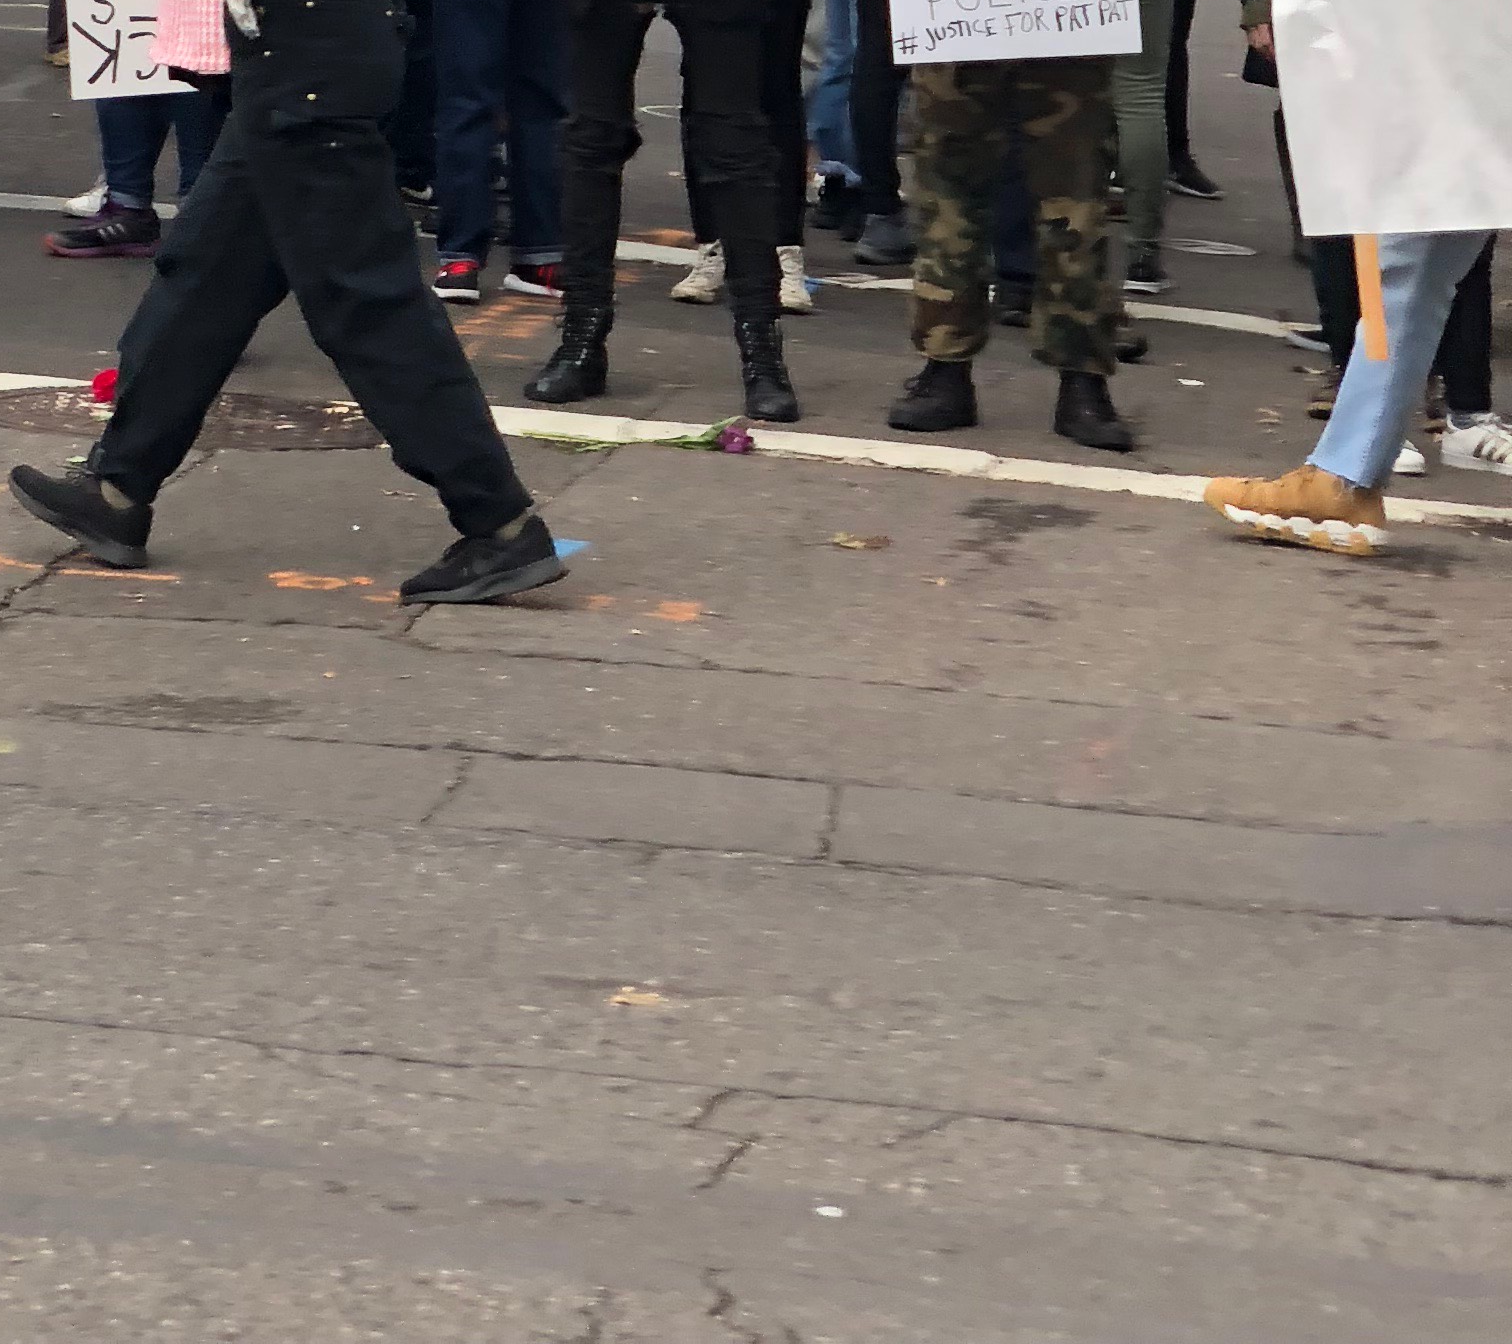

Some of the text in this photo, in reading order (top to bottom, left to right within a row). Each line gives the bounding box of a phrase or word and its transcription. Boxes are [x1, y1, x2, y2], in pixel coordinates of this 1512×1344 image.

[1004, 8, 1051, 37] FOR
[1055, 4, 1093, 32] PAT
[1098, 0, 1134, 26] PAT
